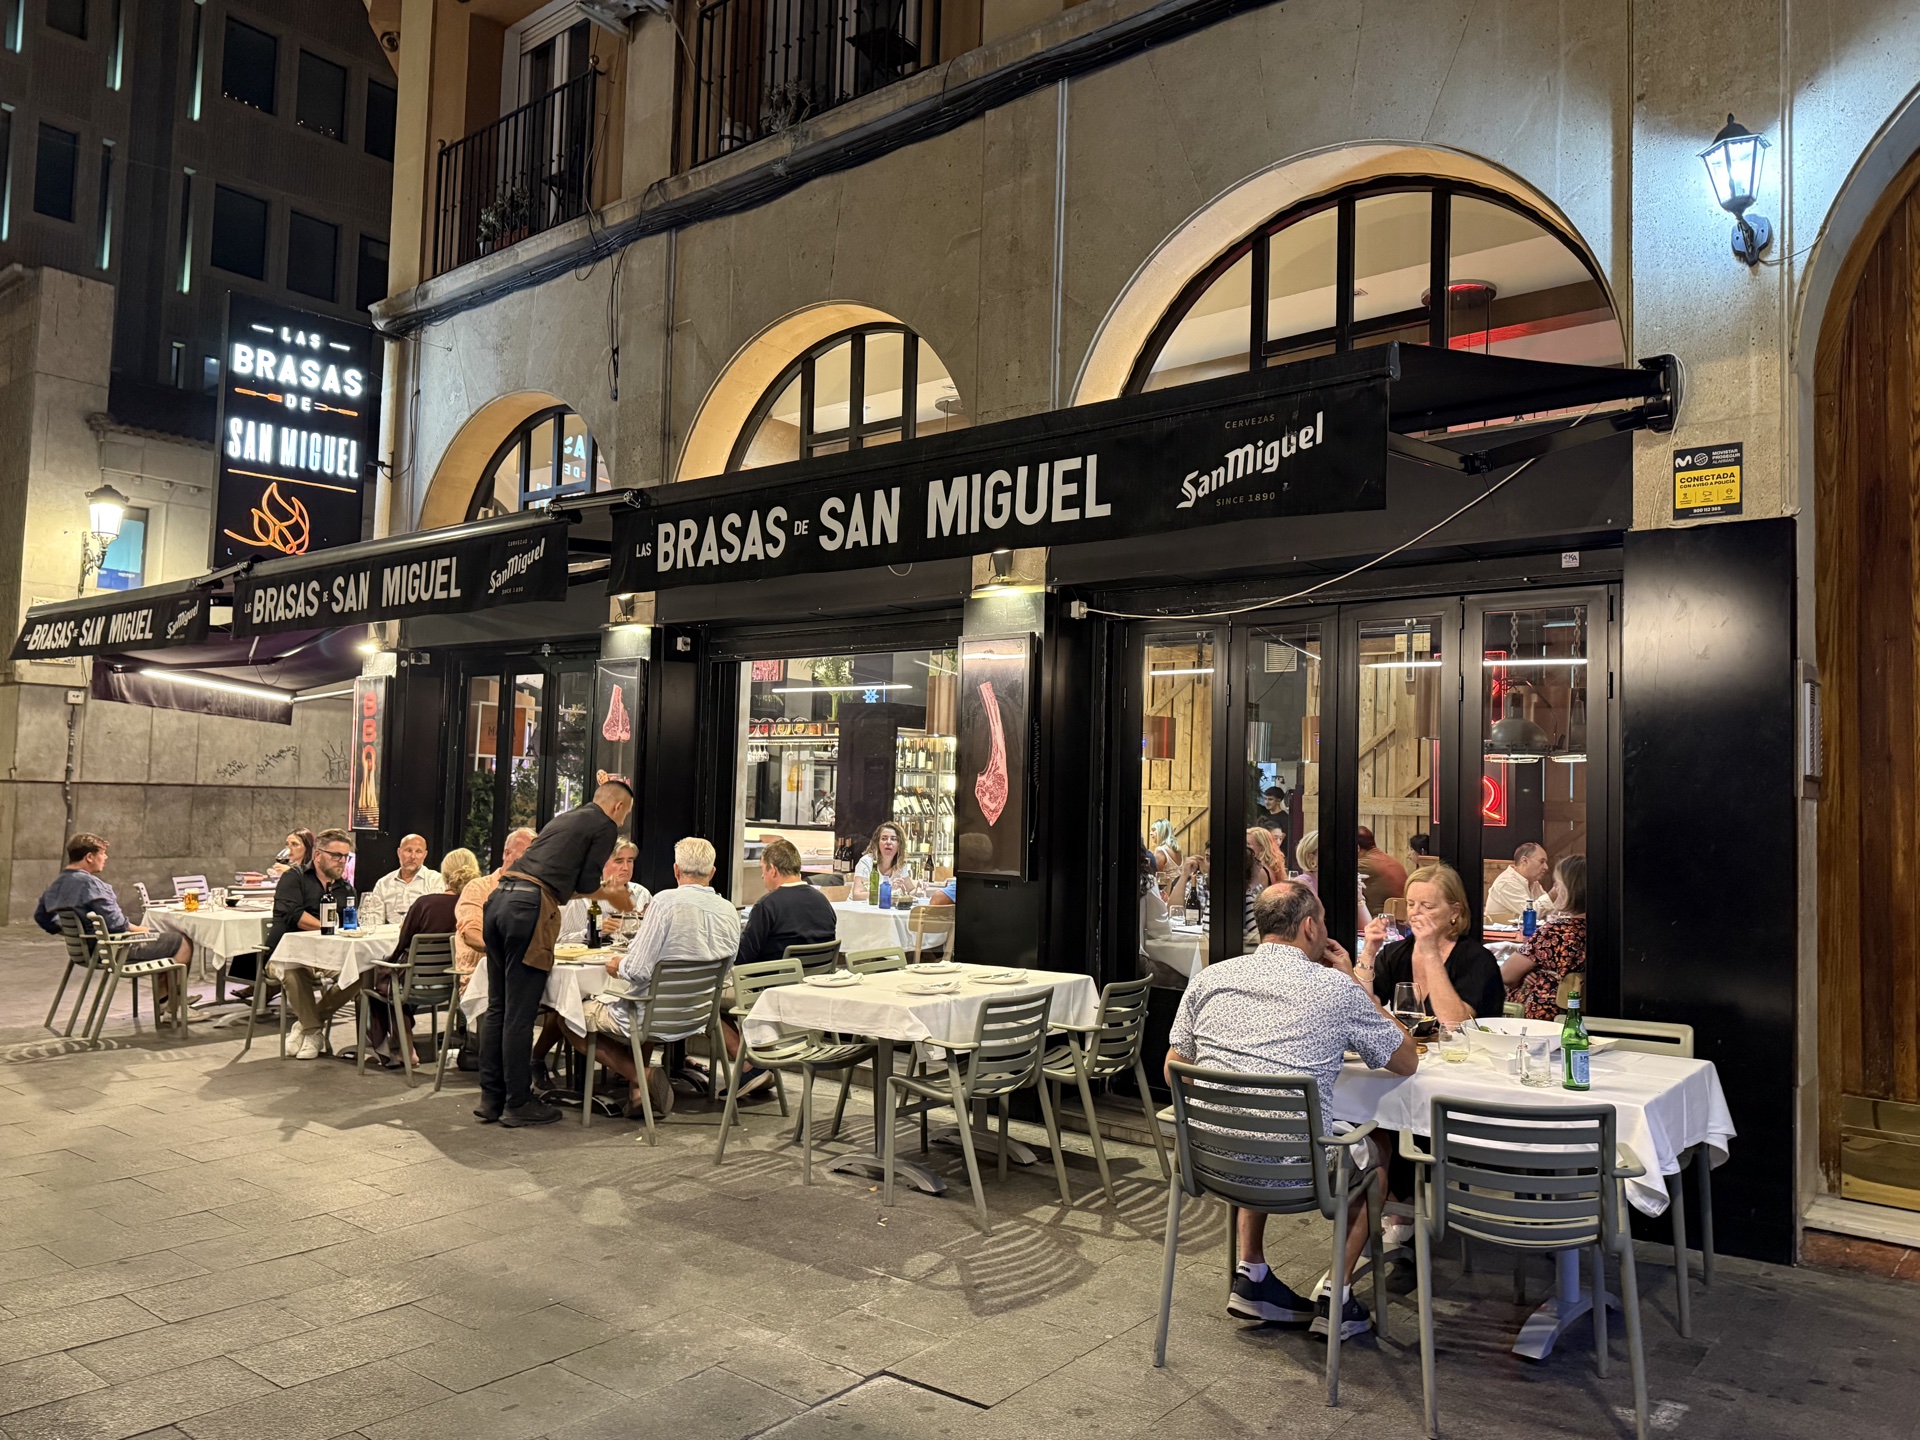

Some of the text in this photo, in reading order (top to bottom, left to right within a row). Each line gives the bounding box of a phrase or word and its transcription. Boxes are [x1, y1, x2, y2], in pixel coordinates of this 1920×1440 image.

[281, 327, 320, 349] LAS
[233, 343, 362, 397] BRASAS
[284, 393, 311, 411] DE
[1224, 414, 1275, 429] CERVEZAS
[228, 417, 358, 478] SAN MIGUEL
[1216, 491, 1276, 507] SINCE 1890
[1680, 472, 1735, 484] CONECTADA
[636, 454, 1111, 572] LAS BRASAS DE SAN MIGUEL
[244, 556, 461, 624] LAS BRASAS DE SAN MIGUEL
[27, 620, 75, 651] BRASAS
[79, 615, 106, 646] SAN
[107, 608, 153, 644] MIGUEL
[361, 691, 378, 771] BBQ
